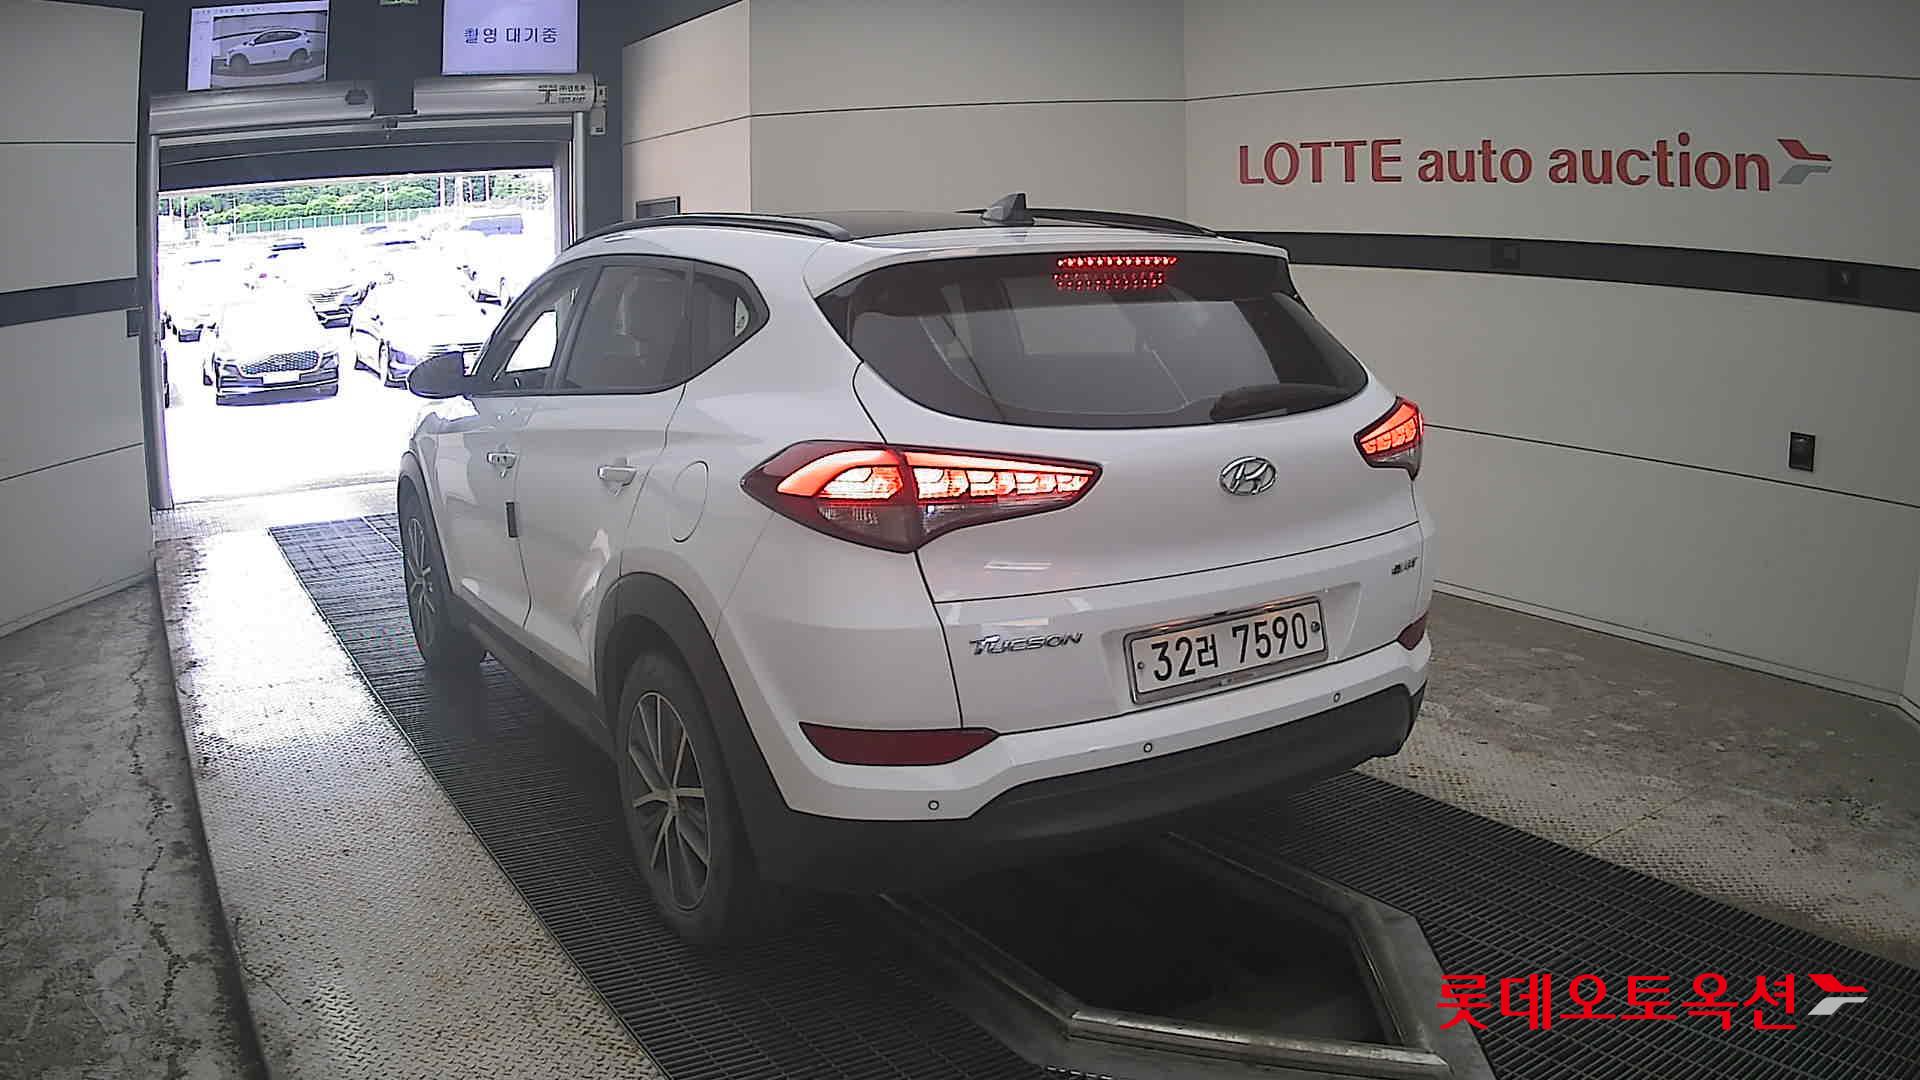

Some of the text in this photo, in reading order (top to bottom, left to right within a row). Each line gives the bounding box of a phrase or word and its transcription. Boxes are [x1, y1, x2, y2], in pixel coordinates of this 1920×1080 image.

[506, 26, 559, 44] 대기중
[1239, 132, 1771, 192] LOTTE auto auction
[1150, 612, 1309, 682] 32러 7590
